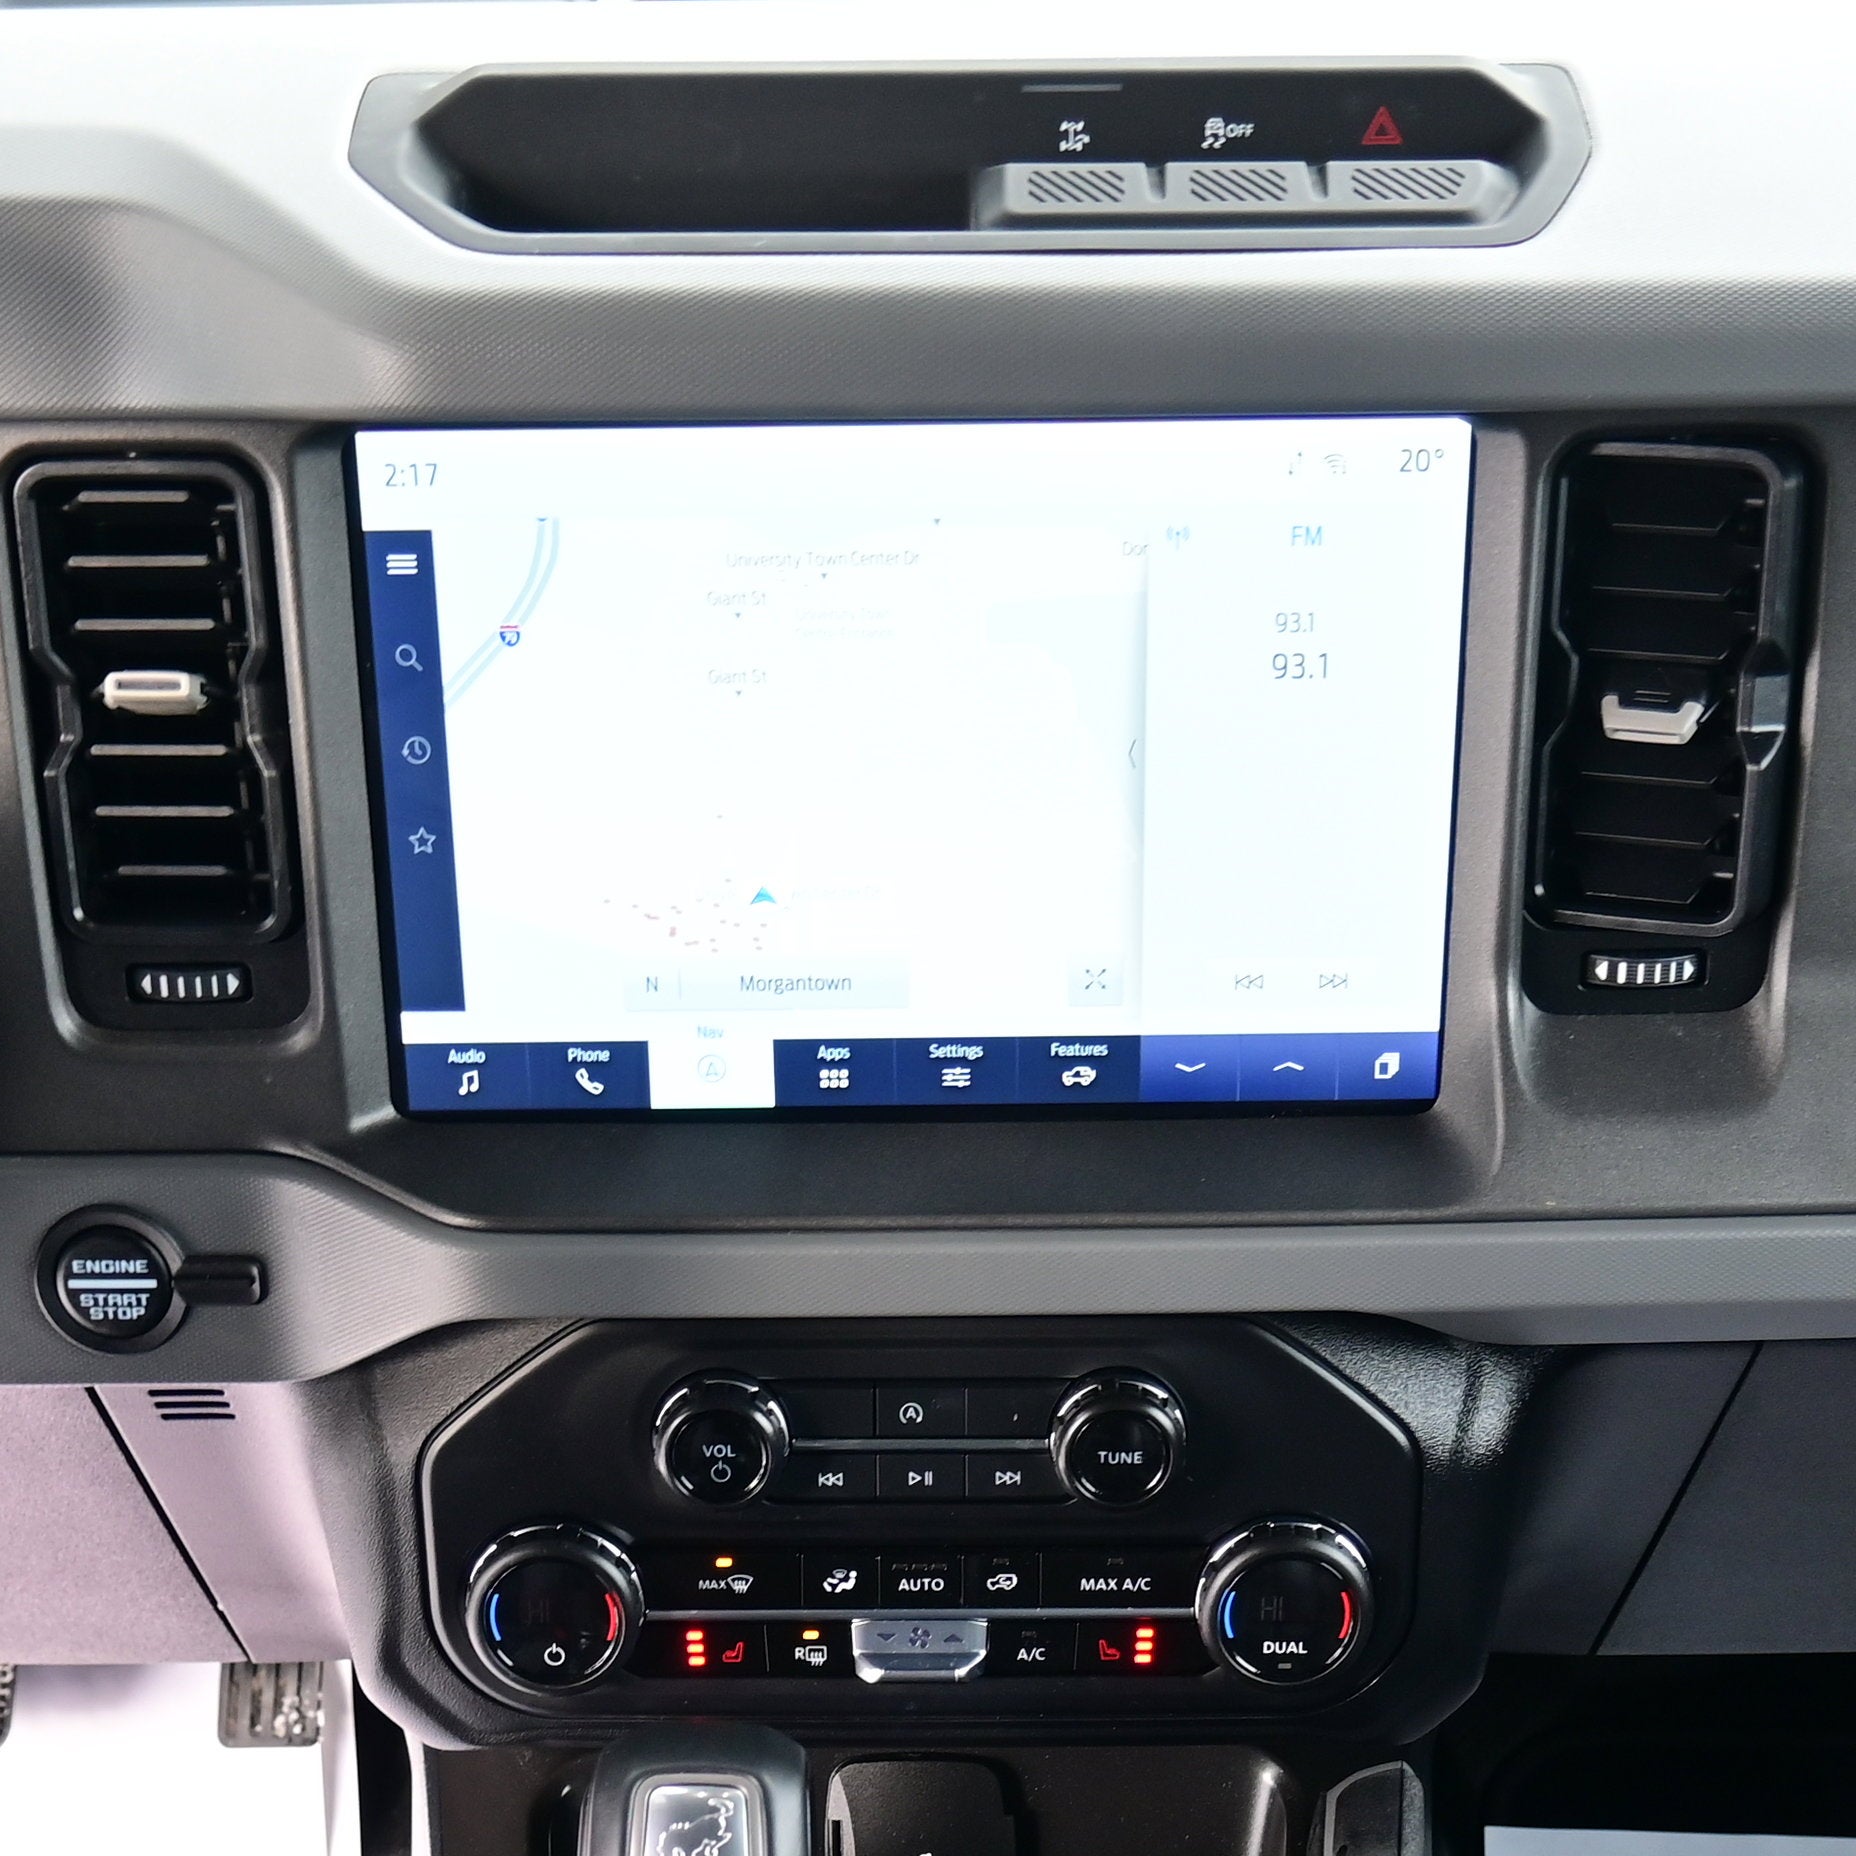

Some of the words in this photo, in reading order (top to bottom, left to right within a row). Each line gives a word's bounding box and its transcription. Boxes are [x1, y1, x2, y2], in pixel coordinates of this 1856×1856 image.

[1225, 123, 1255, 138] OFF
[1399, 449, 1443, 473] 20°
[385, 463, 439, 488] 2:17
[1291, 525, 1324, 547] FM
[726, 551, 801, 569] University
[807, 551, 848, 566] Town
[1275, 612, 1315, 633] 93.1
[1270, 653, 1330, 680] 93.1
[646, 976, 659, 992] N
[740, 974, 852, 995] Morgantown
[697, 1025, 724, 1039] Nav
[448, 1048, 486, 1064] Audio
[567, 1047, 611, 1063] Phone
[816, 1044, 851, 1062] Apps
[928, 1043, 984, 1061] Settings
[1050, 1042, 1109, 1057] Features
[72, 1259, 149, 1274] ENGINE
[80, 1293, 150, 1307] START
[89, 1307, 146, 1321] STOP
[702, 1443, 736, 1458] VOL
[1097, 1451, 1143, 1466] TUNE
[698, 1579, 726, 1590] MAX
[898, 1577, 944, 1592] AUTO
[1080, 1577, 1118, 1592] MAX
[1121, 1577, 1151, 1592] A/C
[1016, 1646, 1046, 1662] A/C
[1262, 1641, 1308, 1655] DUAL
